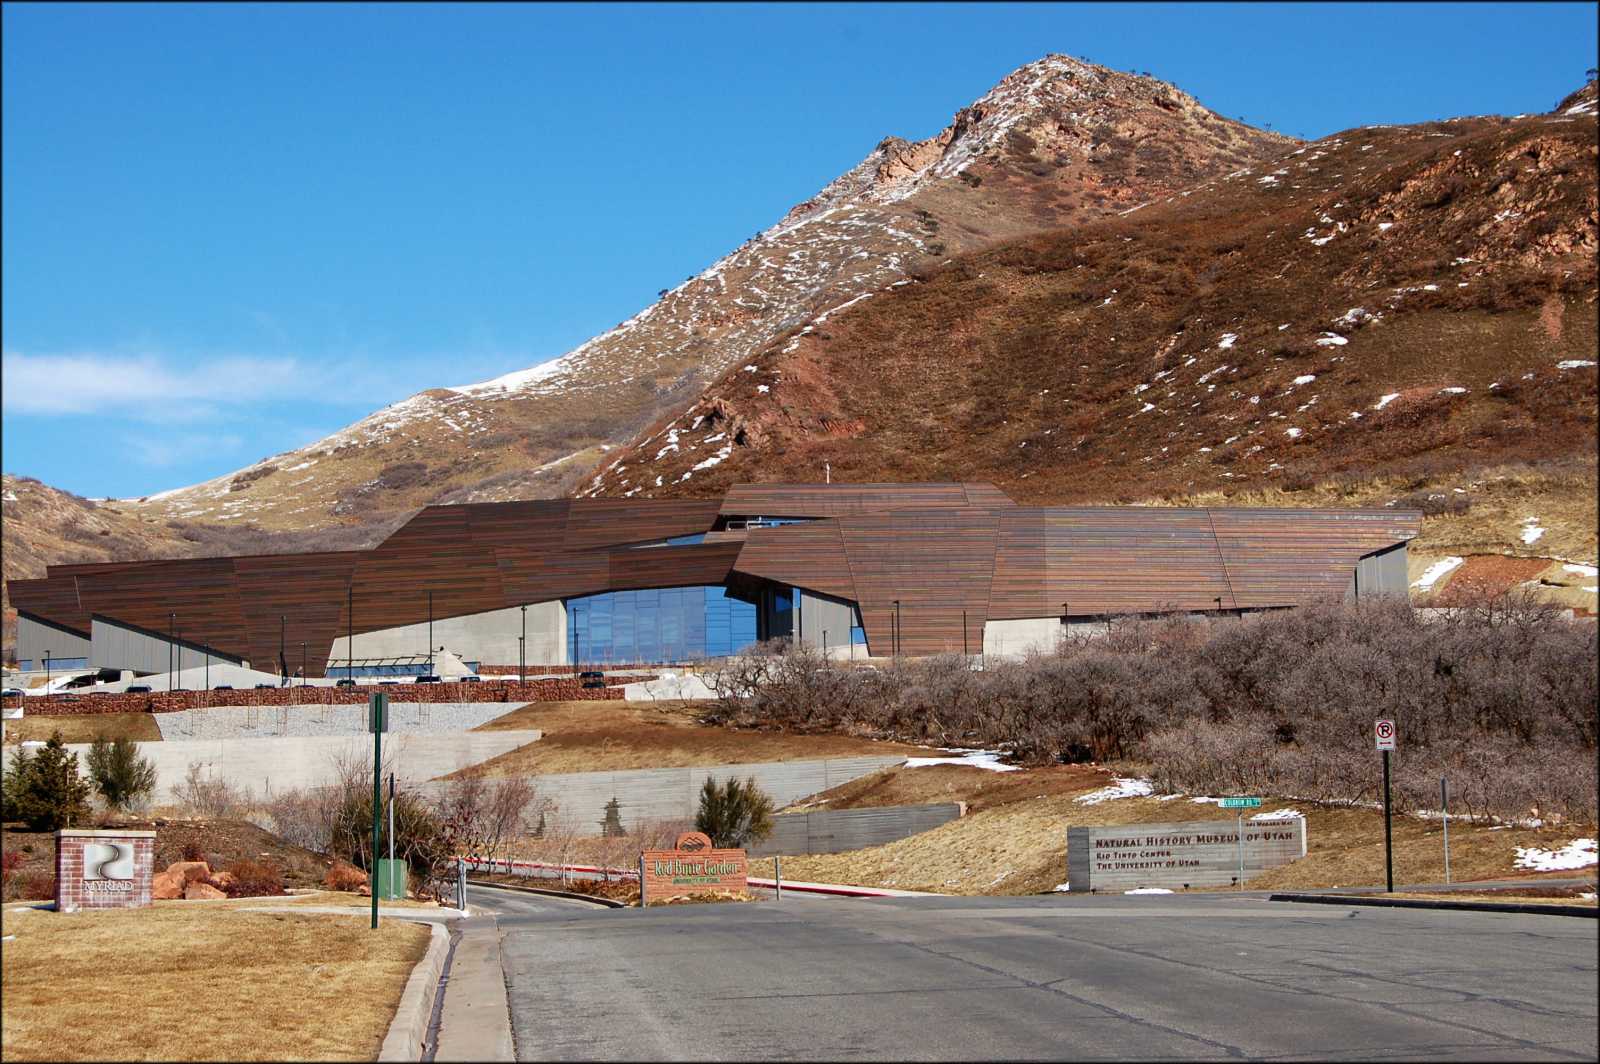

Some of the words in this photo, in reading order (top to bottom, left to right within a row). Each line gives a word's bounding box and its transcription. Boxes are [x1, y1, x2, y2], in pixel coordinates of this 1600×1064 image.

[1096, 838, 1142, 849] NATURAL
[1146, 836, 1191, 847] HISTORY
[1246, 833, 1259, 842] OF
[1264, 832, 1293, 841] UTAH
[1097, 852, 1110, 861] RIO
[1114, 851, 1137, 860] TINTO
[1140, 850, 1171, 858] CENTER
[704, 858, 737, 876] Garden
[1097, 862, 1112, 870] THE
[1115, 860, 1163, 869] UNIVERSITY
[83, 881, 133, 892] MYRIAD
